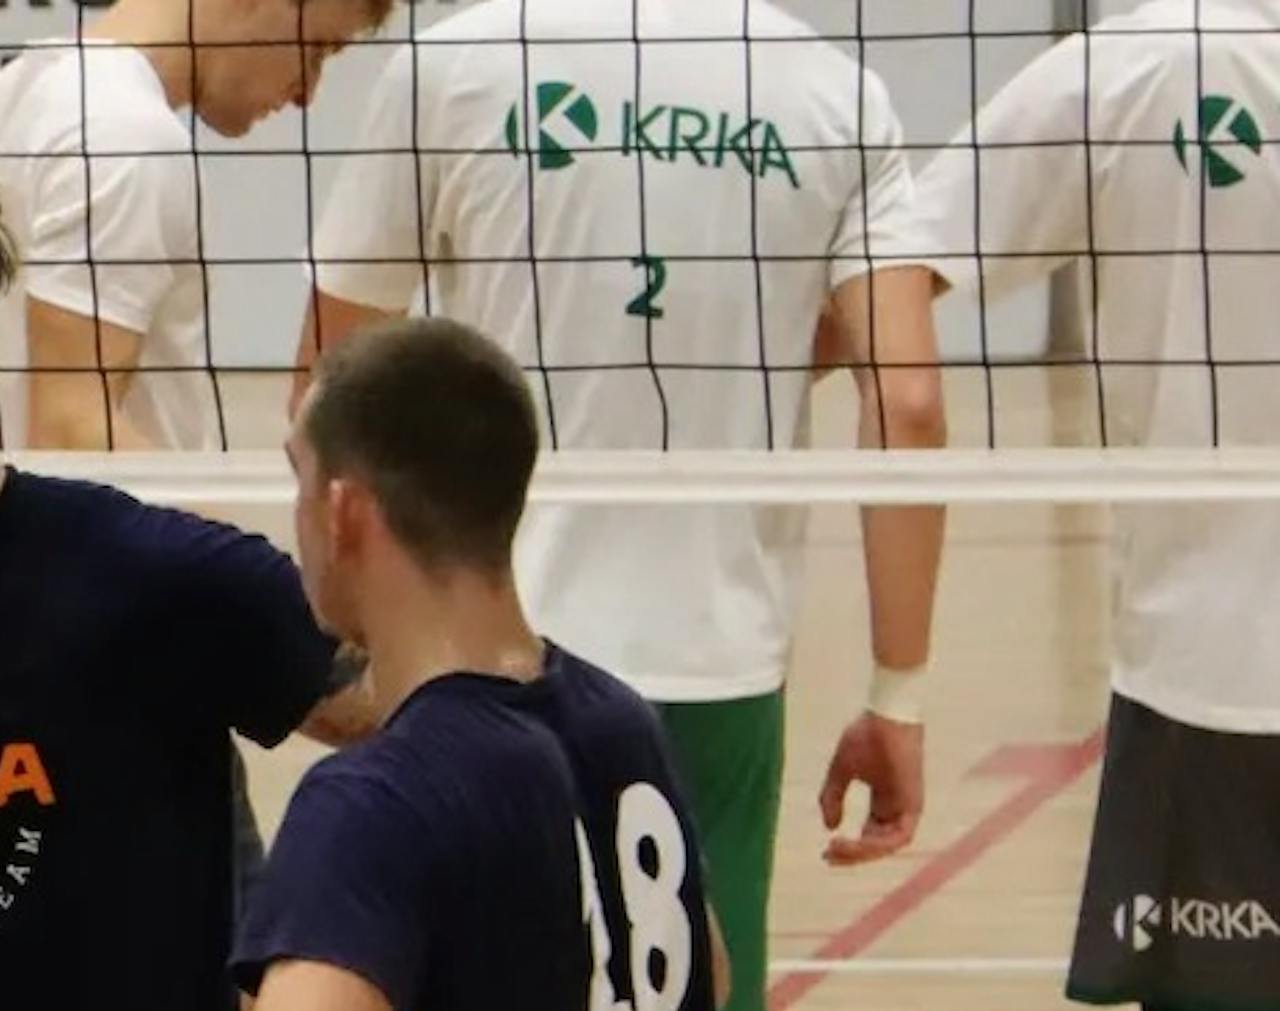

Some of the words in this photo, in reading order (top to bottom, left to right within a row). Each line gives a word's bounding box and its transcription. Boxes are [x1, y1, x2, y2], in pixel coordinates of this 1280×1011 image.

[622, 100, 800, 190] KRKA
[626, 252, 667, 319] 2
[1171, 897, 1280, 940] KRKA
